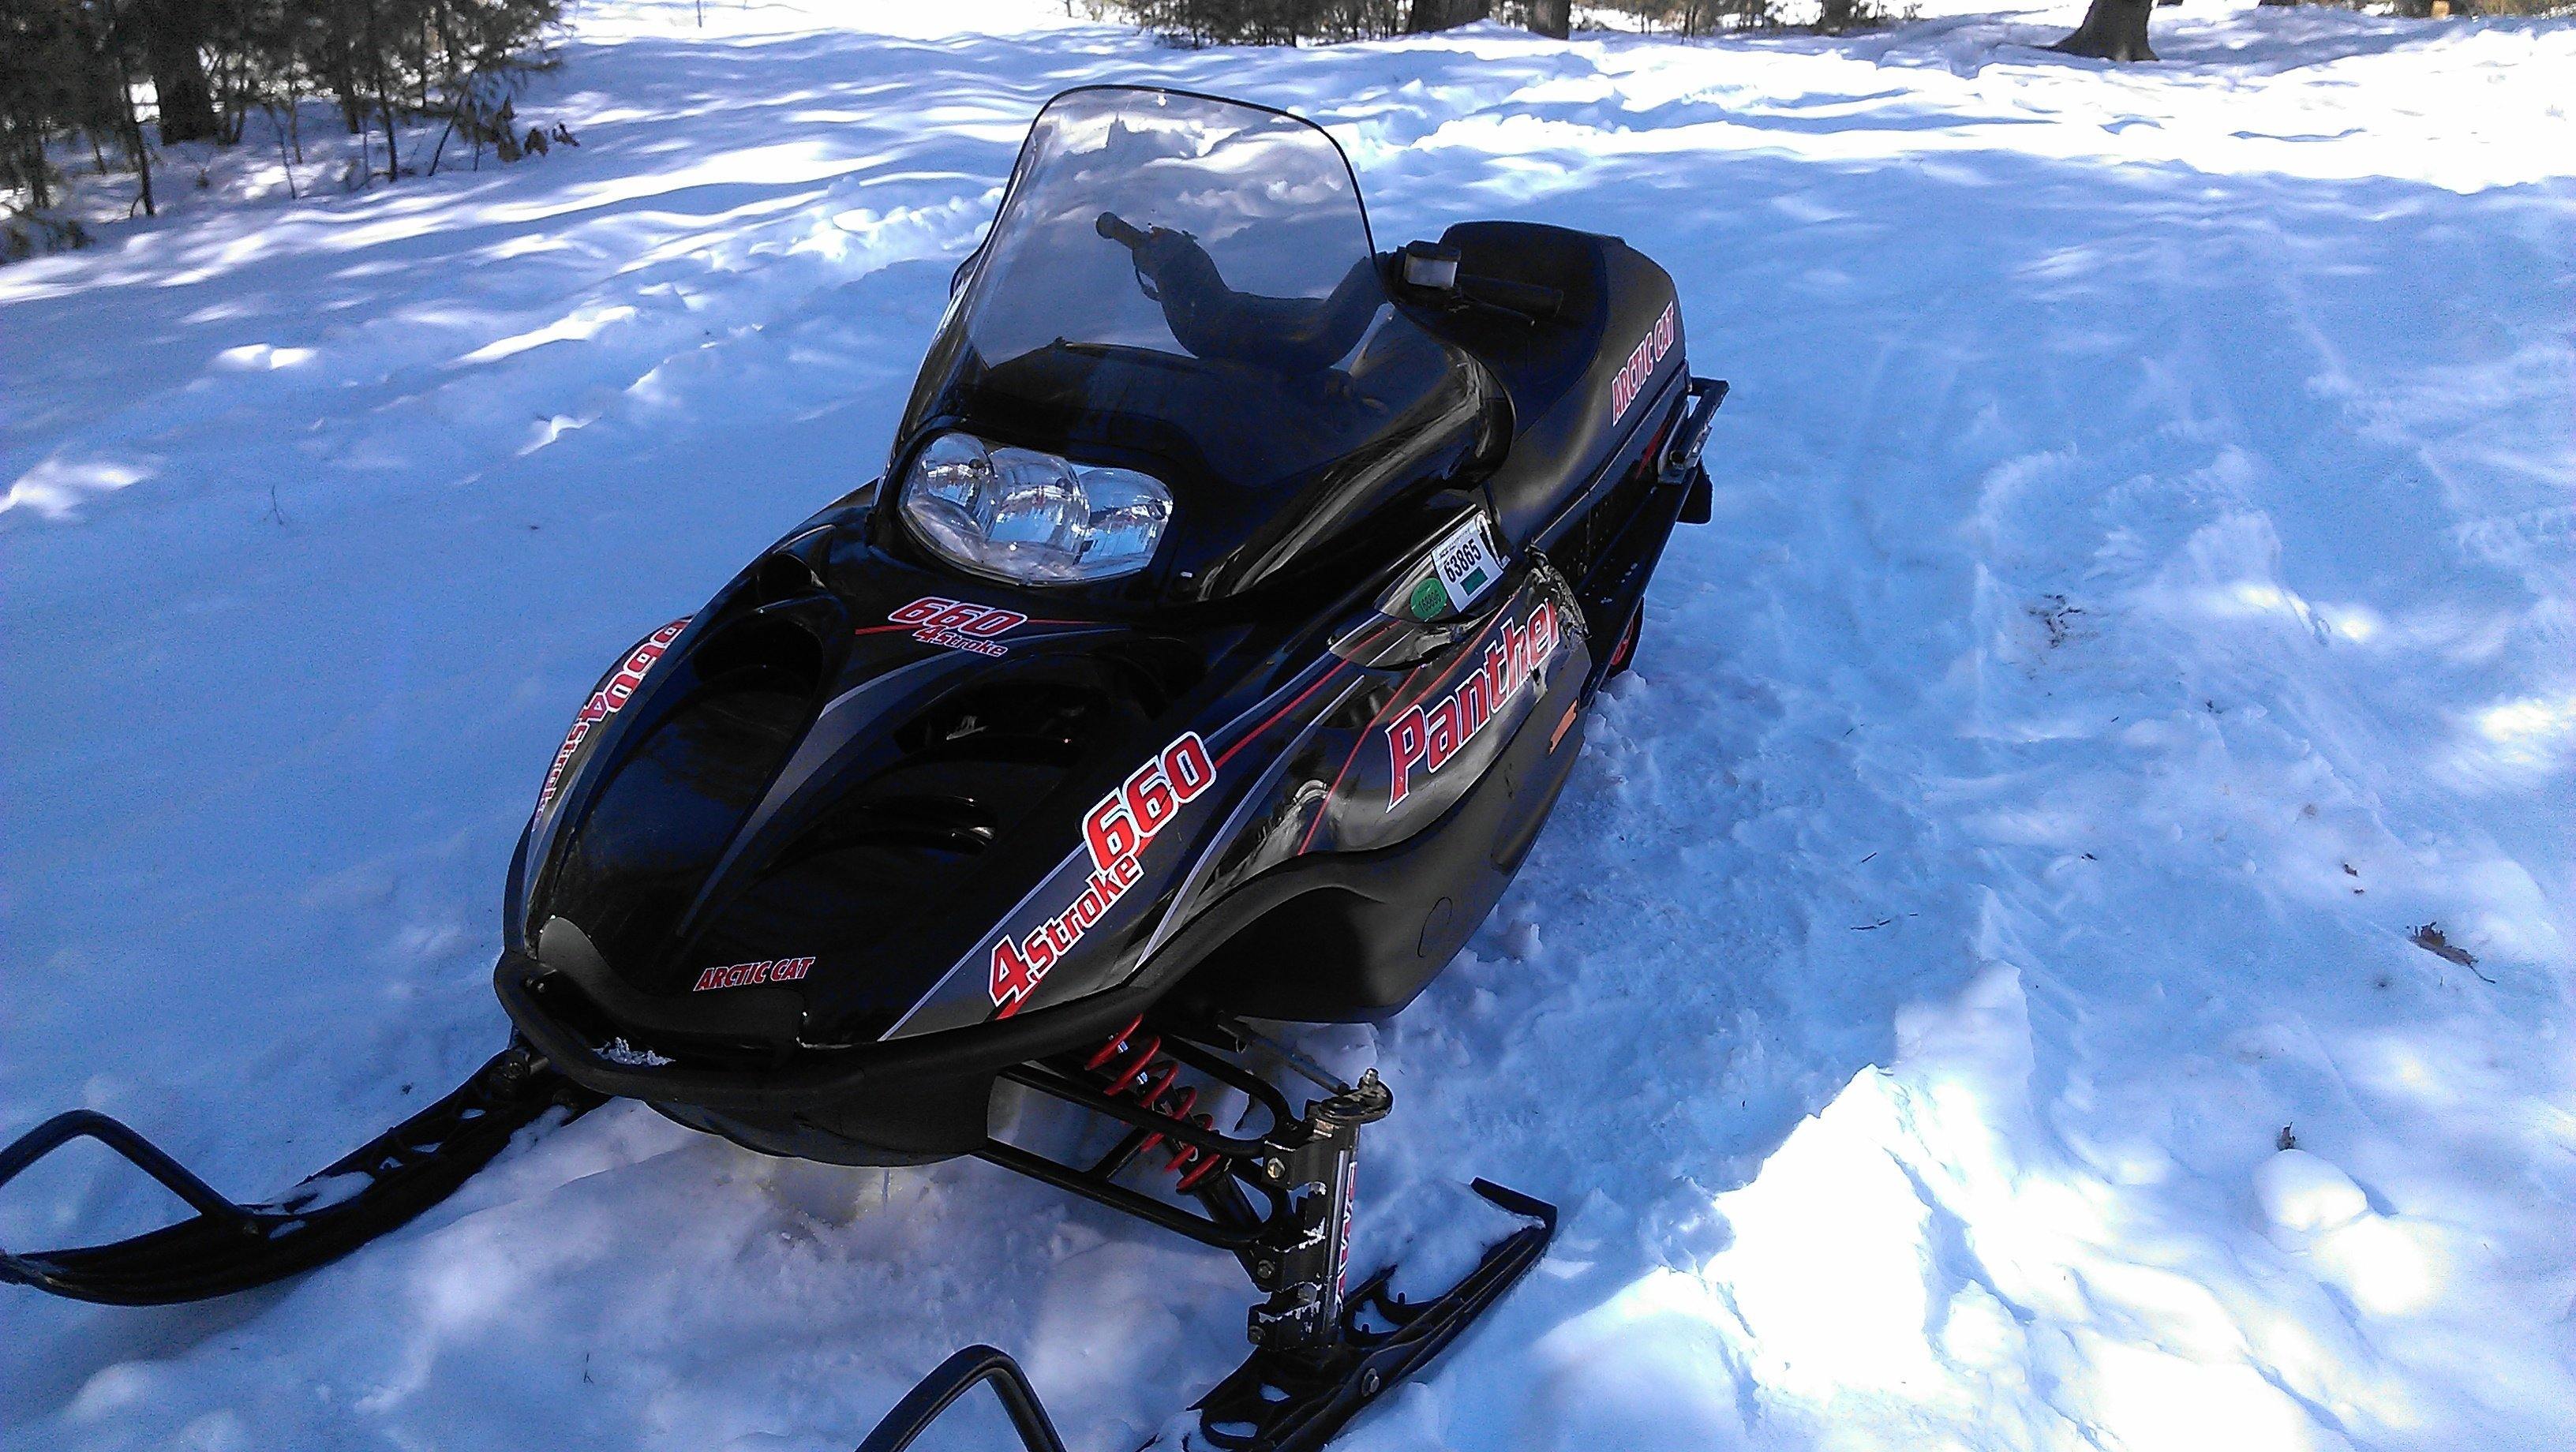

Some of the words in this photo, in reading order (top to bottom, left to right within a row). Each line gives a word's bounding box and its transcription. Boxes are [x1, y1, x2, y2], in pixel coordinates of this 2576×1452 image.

[1611, 331, 1654, 427] ARCTIC
[1653, 301, 1675, 362] CAT
[1443, 538, 1482, 583] 63865
[888, 596, 1028, 638] 660
[1082, 731, 1217, 872] 660
[988, 853, 1144, 1007] 4Stroke
[693, 960, 773, 992] ARCTIC
[770, 956, 816, 982] CAT
